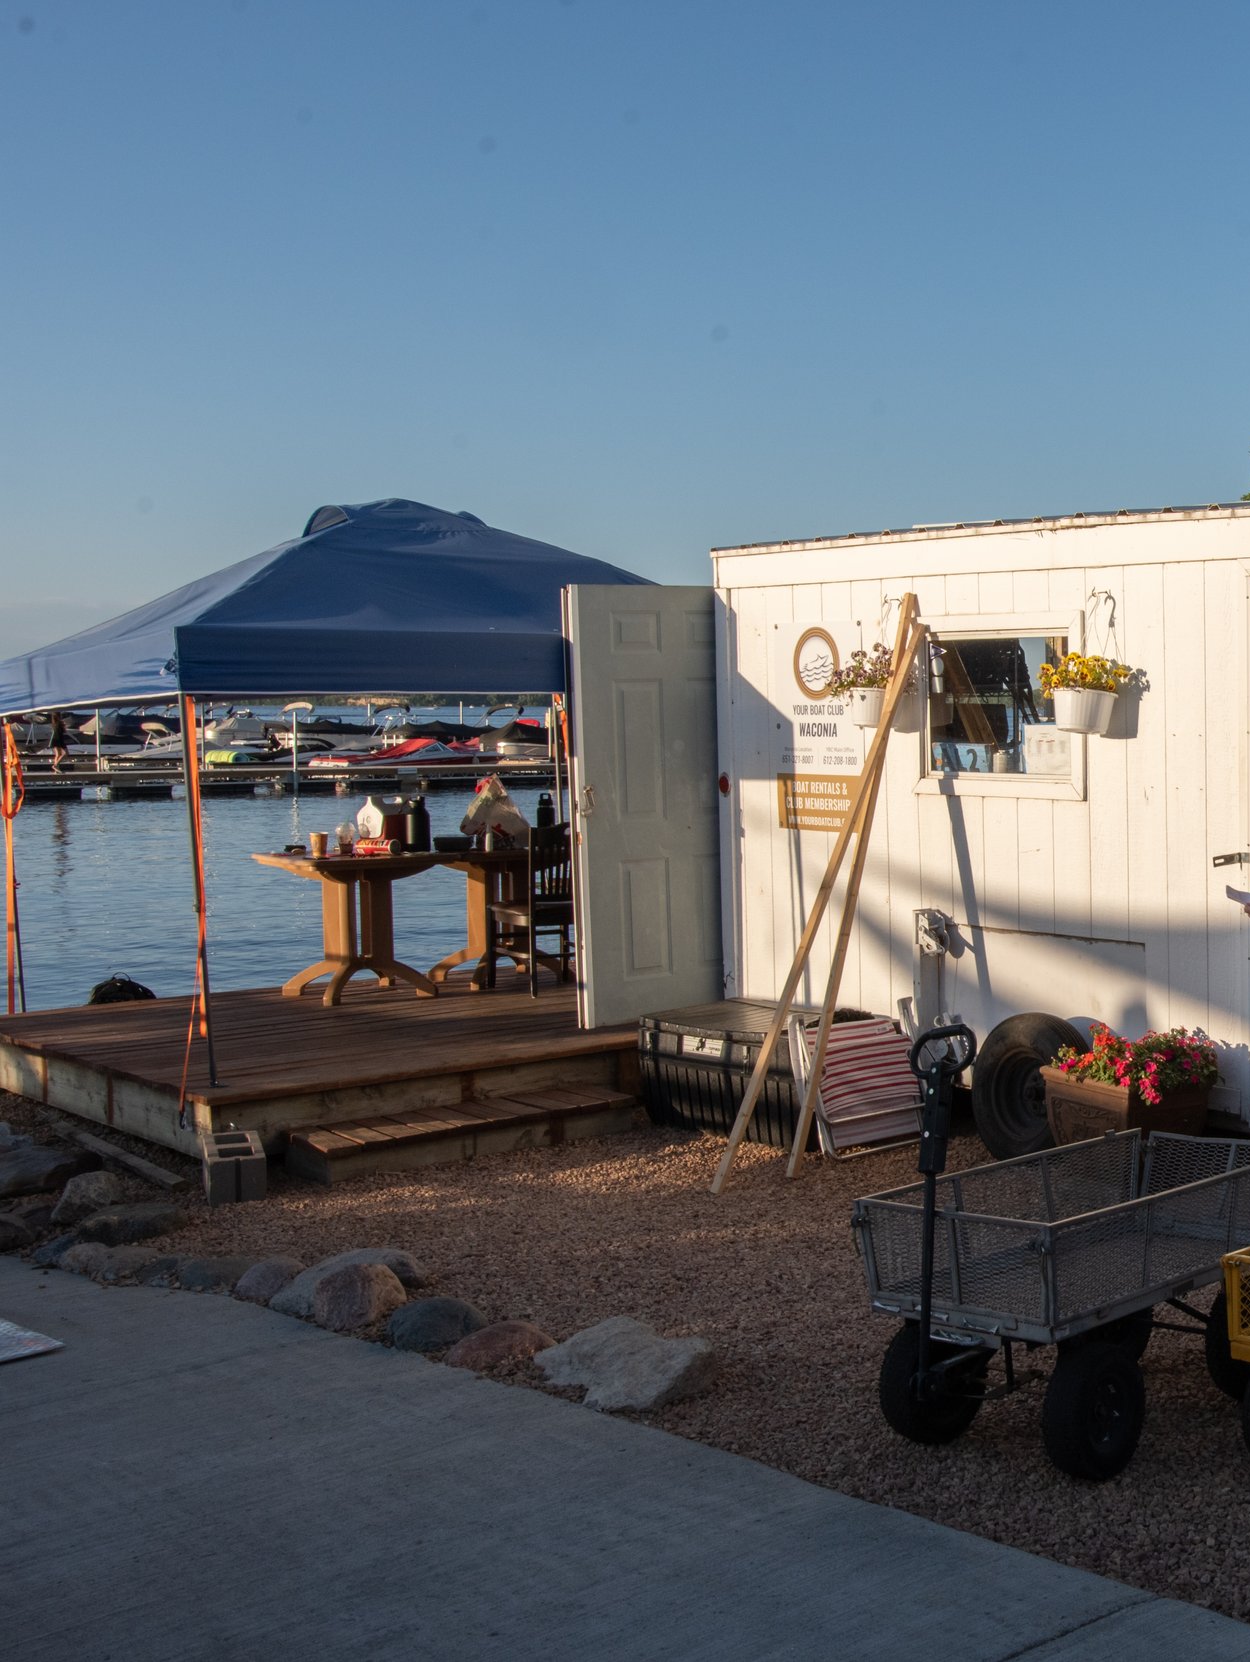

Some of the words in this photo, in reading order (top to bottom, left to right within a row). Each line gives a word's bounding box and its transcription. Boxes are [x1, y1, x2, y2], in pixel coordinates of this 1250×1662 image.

[793, 704, 809, 715] YOUR
[810, 705, 825, 716] BOAT
[827, 705, 845, 716] CLUB
[799, 722, 838, 738] WACONIA
[792, 781, 809, 793] BOAT
[810, 782, 840, 795] RENTALS
[842, 783, 848, 795] &
[786, 796, 803, 809] CLUB
[805, 797, 851, 811] MEMBERSHIP
